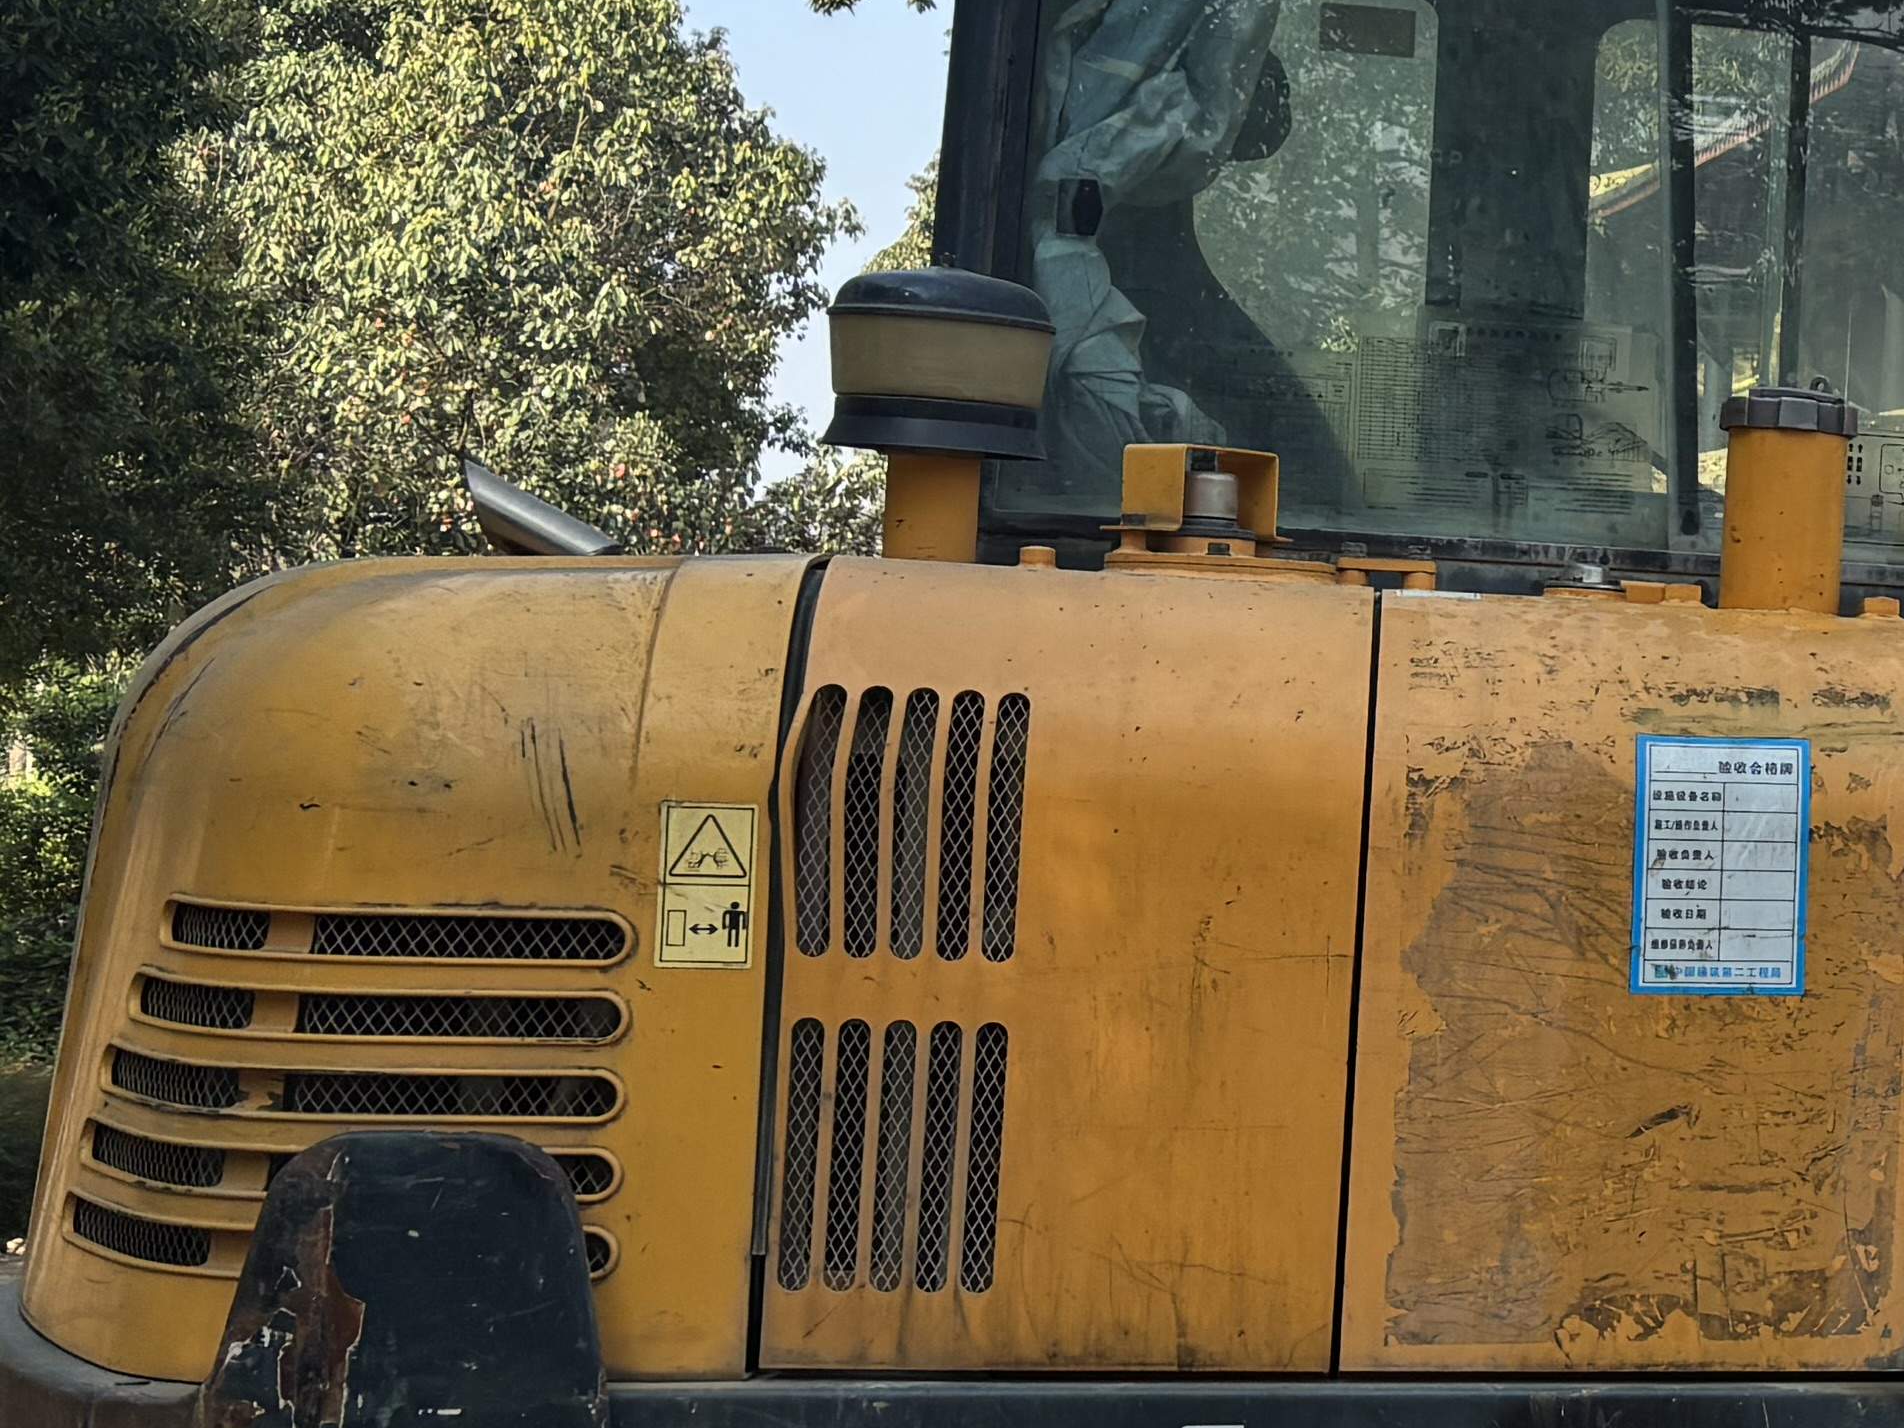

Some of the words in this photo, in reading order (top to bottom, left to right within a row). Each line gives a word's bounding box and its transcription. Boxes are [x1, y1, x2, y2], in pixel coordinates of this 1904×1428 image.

[1718, 760, 1793, 776] 验收合格牌
[1653, 789, 1722, 802] 设施设备名称
[1656, 848, 1714, 861] 验收负责人
[1661, 878, 1708, 891] 验收结论
[1660, 908, 1707, 920] 验收日期
